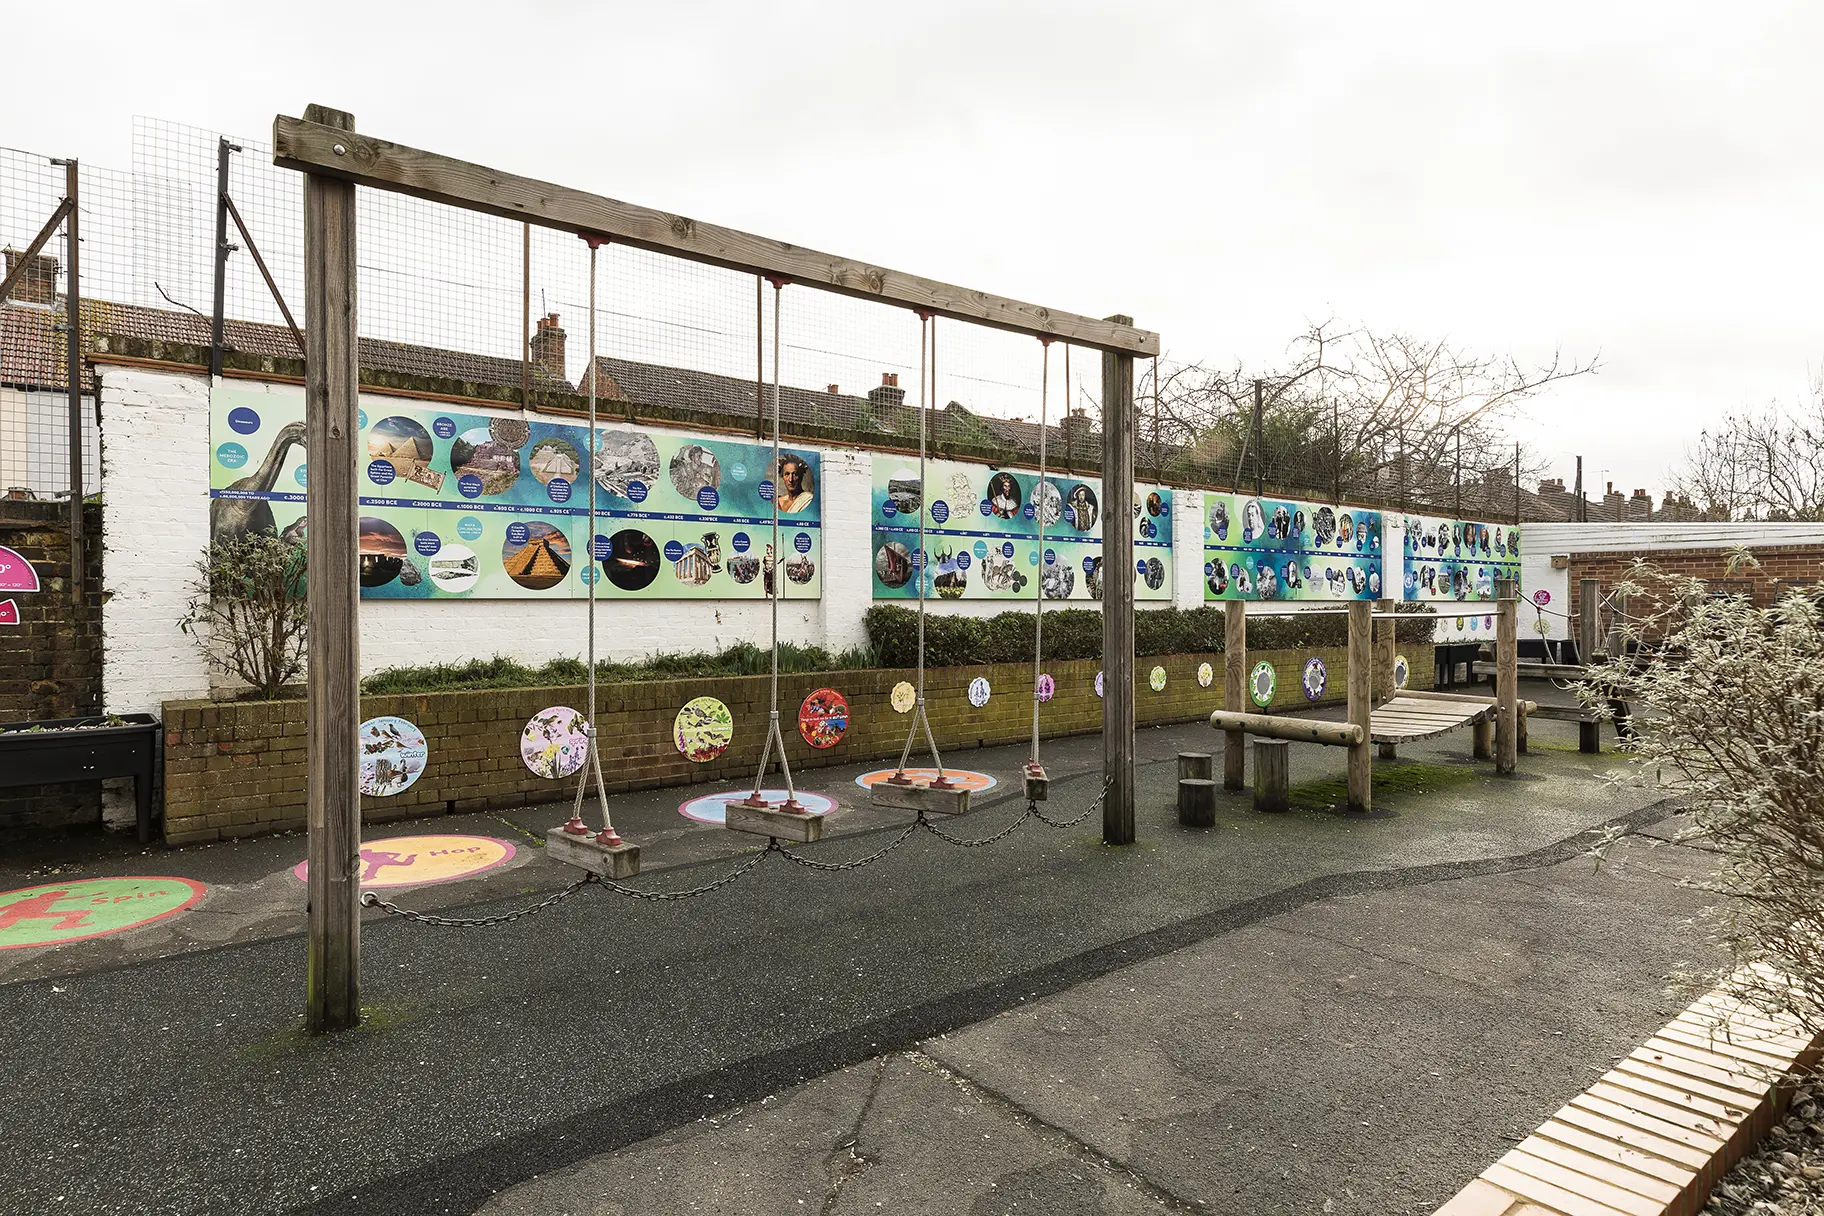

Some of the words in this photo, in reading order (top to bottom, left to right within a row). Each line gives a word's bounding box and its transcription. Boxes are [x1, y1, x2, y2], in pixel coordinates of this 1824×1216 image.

[400, 750, 426, 758] winter
[429, 846, 481, 856] Hop
[90, 890, 168, 906] Spin
